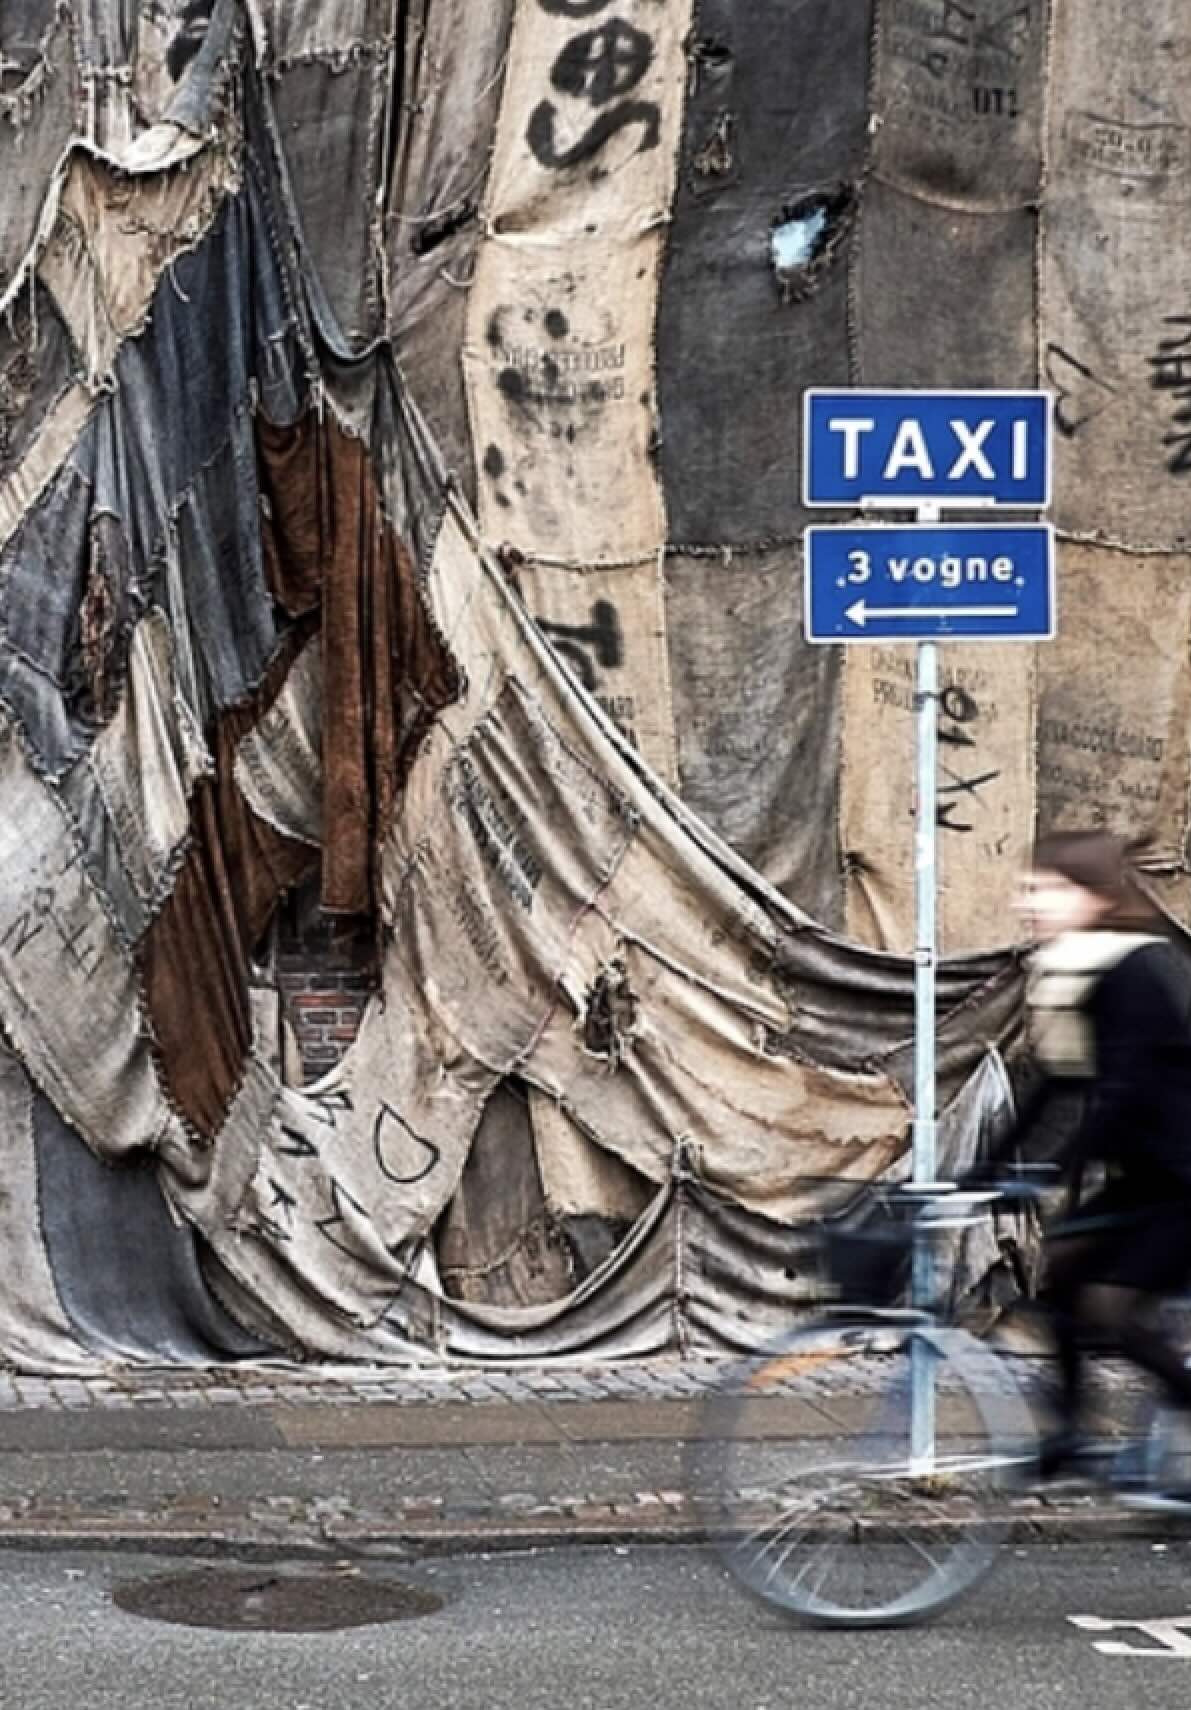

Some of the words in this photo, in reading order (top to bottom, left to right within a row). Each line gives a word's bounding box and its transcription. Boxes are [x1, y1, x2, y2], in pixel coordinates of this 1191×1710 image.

[829, 417, 1028, 480] TAXI
[847, 550, 872, 583] 3
[887, 556, 1014, 588] vogne
